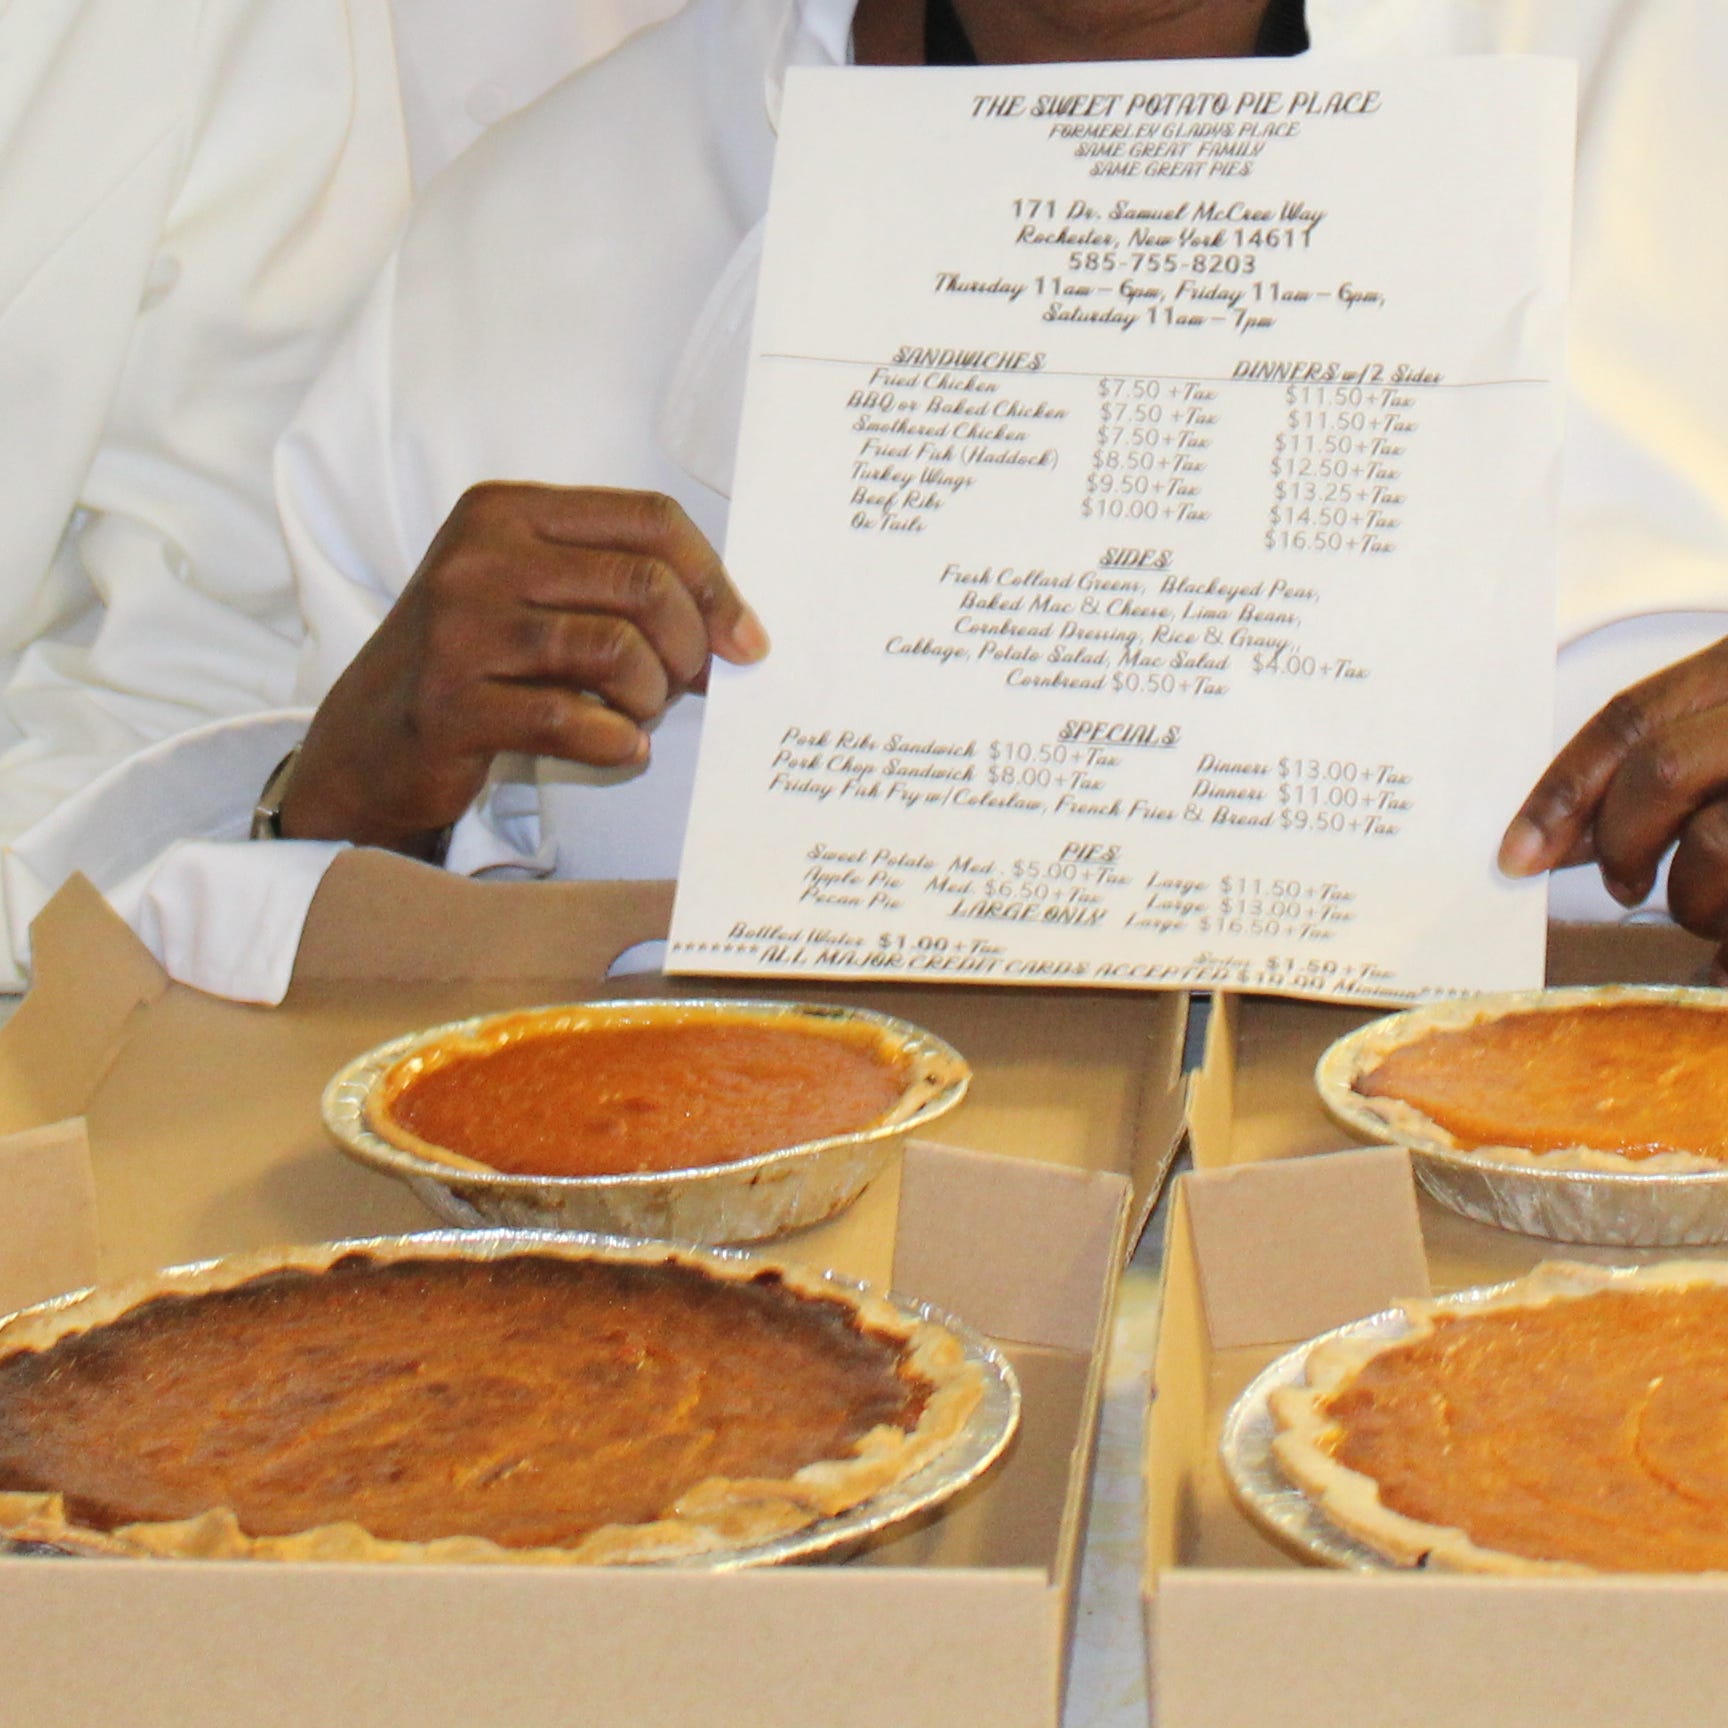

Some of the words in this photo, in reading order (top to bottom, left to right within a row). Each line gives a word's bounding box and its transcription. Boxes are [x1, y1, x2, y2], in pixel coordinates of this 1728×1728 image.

[971, 94, 1026, 118] THE
[1030, 94, 1125, 117] SWEET
[1126, 92, 1232, 117] POTATO
[1235, 91, 1285, 116] PIE
[1288, 90, 1382, 115] PLACE
[1049, 123, 1160, 140] FORMERLEY
[1162, 122, 1235, 139] GLADYS
[1237, 121, 1301, 138] PLACE
[1074, 142, 1125, 158] SAME
[1129, 142, 1191, 158] GREAT
[1198, 141, 1266, 157] FAMILY
[1089, 161, 1140, 177] SAME
[1144, 161, 1207, 177] GREAT
[1209, 160, 1255, 176] PIES
[1013, 198, 1057, 219] 171
[1066, 200, 1102, 221] Dr.
[1108, 200, 1188, 222] Samuel
[1192, 201, 1275, 223] McCree
[1280, 202, 1327, 229] Way
[1015, 225, 1119, 250] Rochester,
[1129, 226, 1173, 248] New
[1179, 226, 1228, 248] York
[1234, 227, 1314, 248] 14611
[1068, 252, 1257, 274] 585-755-8203
[935, 273, 1027, 301] Thursday
[1034, 277, 1094, 297] 11am
[1173, 280, 1246, 308] Friday
[1252, 281, 1311, 302] 11am
[1042, 303, 1140, 331] Saturday
[1147, 306, 1206, 327] 11am
[1234, 309, 1279, 333] 7pm
[892, 345, 1047, 371] SANDWICHES
[1232, 360, 1340, 383] DINNERS
[1391, 363, 1445, 384] Sides
[869, 368, 918, 387] Fried
[923, 371, 999, 394] Chicken
[1097, 378, 1160, 401] $7.50
[847, 391, 895, 412] BBQ
[897, 400, 920, 412] or
[926, 395, 987, 417] Baked
[991, 399, 1070, 421] Chicken
[1100, 402, 1162, 424] $7.50
[852, 414, 949, 438] Smothered
[952, 419, 1031, 442] Chicken
[859, 438, 912, 459] Fried
[916, 442, 956, 463] Fish
[961, 445, 1059, 470] (Haddock)
[851, 461, 916, 488] Turkey
[920, 465, 978, 490] Wings
[850, 486, 897, 511] Beef
[902, 488, 945, 510] Ribs
[850, 511, 875, 530] Ox
[880, 511, 928, 533] Tails
[1099, 547, 1174, 569] SIDES
[939, 564, 994, 586] Fresh
[997, 567, 1074, 589] Collard
[1077, 571, 1147, 595] Greens,
[1159, 575, 1264, 602] Blackeyed
[1268, 579, 1320, 603] Peas,
[959, 591, 1024, 613] Baked
[1028, 593, 1073, 615] Mac
[1079, 597, 1102, 616] &
[1105, 598, 1176, 621] Cheese,
[1183, 600, 1230, 621] Lima
[1238, 603, 1301, 626] Beans,
[954, 616, 1052, 639] Cornbread
[1059, 621, 1144, 647] Dressing,
[1151, 625, 1200, 646] Rice
[1205, 627, 1224, 645] &
[885, 636, 971, 661] Cabbage,
[977, 640, 1043, 662] Potato
[1047, 645, 1110, 669] Salad,
[1118, 647, 1164, 669] Mac
[1169, 650, 1231, 671] Salad
[1005, 669, 1106, 691] Cornbread
[780, 726, 828, 747] Pork
[836, 730, 877, 751] Ribs
[883, 734, 976, 759] Sandwich
[1059, 720, 1181, 748] SPECIALS
[772, 750, 822, 771] Pork
[826, 753, 875, 779] Chop
[882, 758, 976, 783] Sandwich
[1197, 753, 1272, 777] Dinners
[769, 773, 836, 799] Friday
[840, 778, 880, 799] Fish
[886, 783, 923, 806] Fry
[1055, 794, 1121, 818] French
[1127, 800, 1176, 821] Fries
[1183, 803, 1202, 821] &
[1212, 806, 1274, 827] Bread
[1192, 778, 1266, 801] Dinners
[1059, 843, 1120, 864] PIES
[807, 843, 867, 862] Sweet
[871, 848, 935, 869] Potato
[1145, 871, 1210, 893] Large
[803, 864, 865, 887] Apple
[869, 869, 904, 889] Pie
[1145, 894, 1210, 915] Large
[800, 886, 865, 908] Pecan
[869, 890, 905, 910] Pie
[948, 899, 1039, 922] LARGE
[1044, 905, 1110, 927] ONLY
[1125, 912, 1187, 932] Large
[728, 922, 802, 943] Bottled
[806, 927, 866, 948] Water
[816, 949, 904, 969] MAJOR
[905, 954, 1004, 973] CREDIT
[1004, 958, 1090, 977] CARDS
[1095, 961, 1230, 983] ACCEPTED
